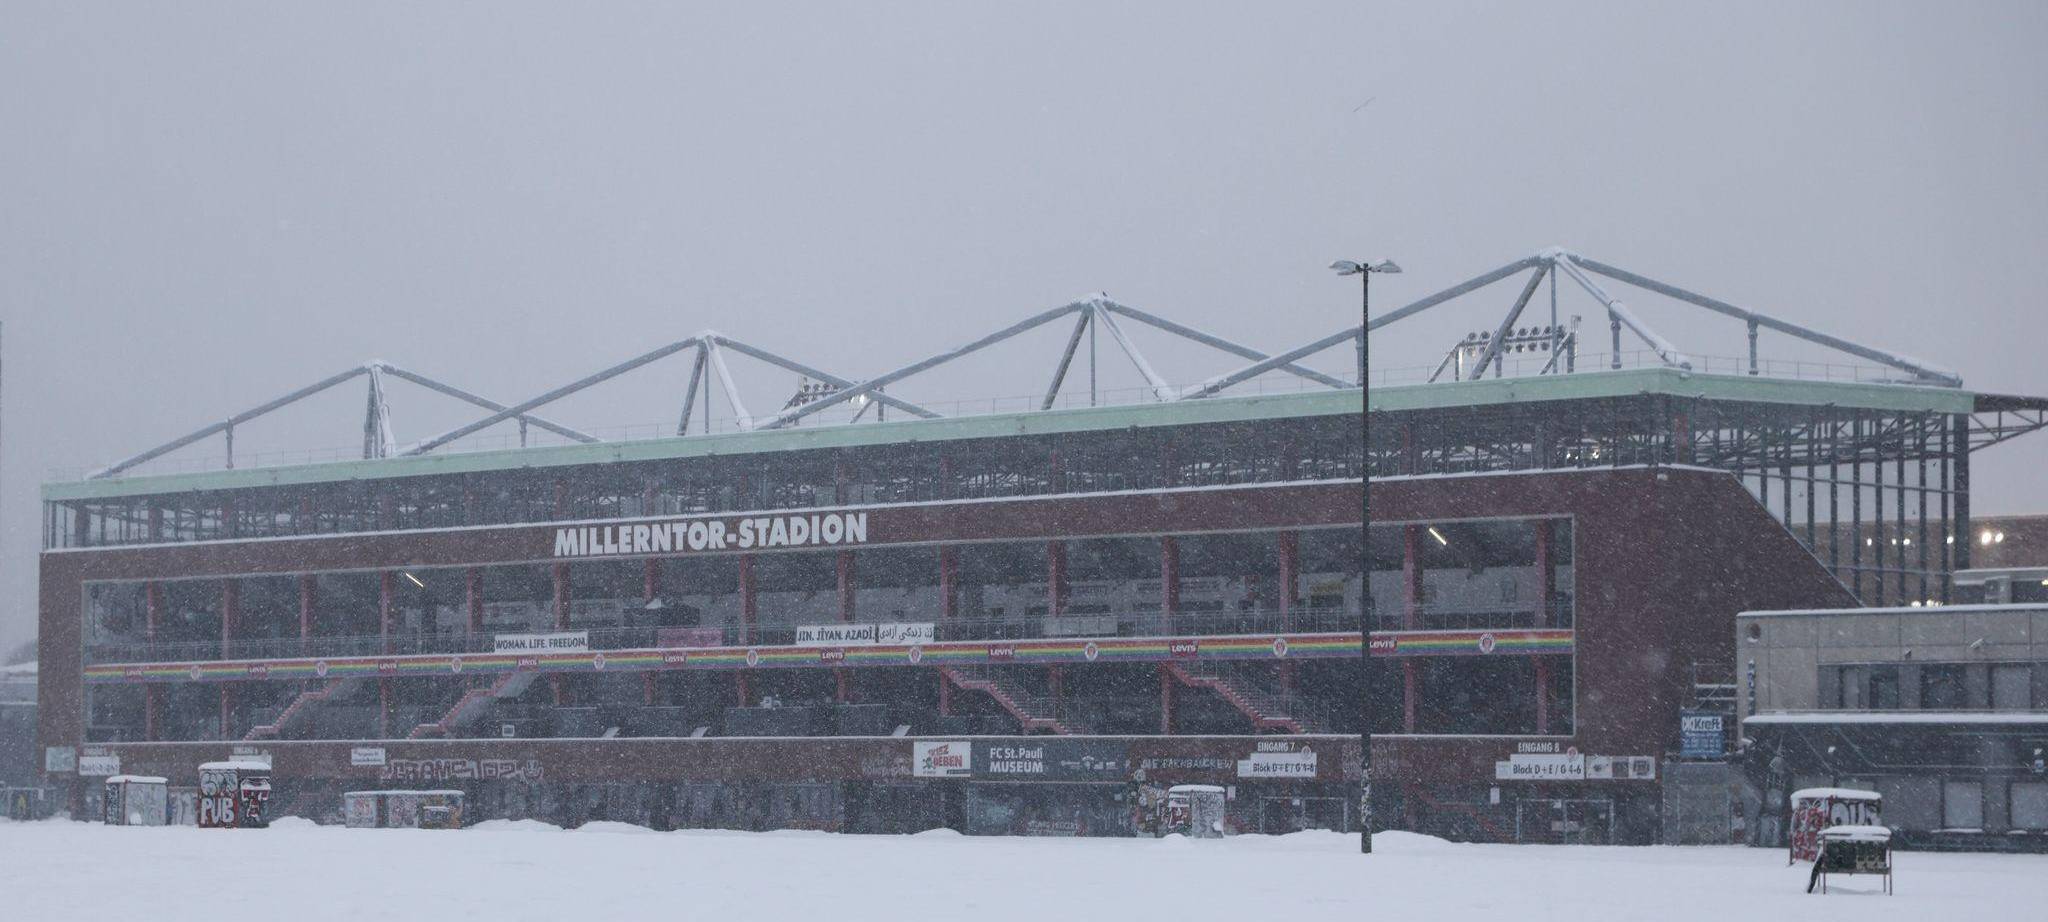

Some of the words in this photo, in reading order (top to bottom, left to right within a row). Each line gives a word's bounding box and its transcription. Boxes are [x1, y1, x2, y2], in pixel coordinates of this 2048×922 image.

[554, 513, 867, 556] MILLERNTOR-STADION
[495, 639, 528, 650] WOMAN.
[1257, 741, 1289, 752] EINGANG
[1289, 742, 1296, 752] 7
[1518, 741, 1553, 752] EINGANG
[1554, 741, 1560, 752] 8
[990, 748, 1003, 759] FC
[1005, 748, 1018, 759] St.
[1019, 747, 1043, 759] Pauli
[990, 761, 1043, 773] MUSEUM
[1252, 763, 1271, 773] Block
[1272, 763, 1278, 773] D
[1513, 764, 1533, 774] Block
[1534, 765, 1540, 774] D
[1548, 764, 1553, 774] E
[1560, 764, 1567, 774] G
[1568, 764, 1582, 774] 4-6
[200, 797, 235, 825] PUB
